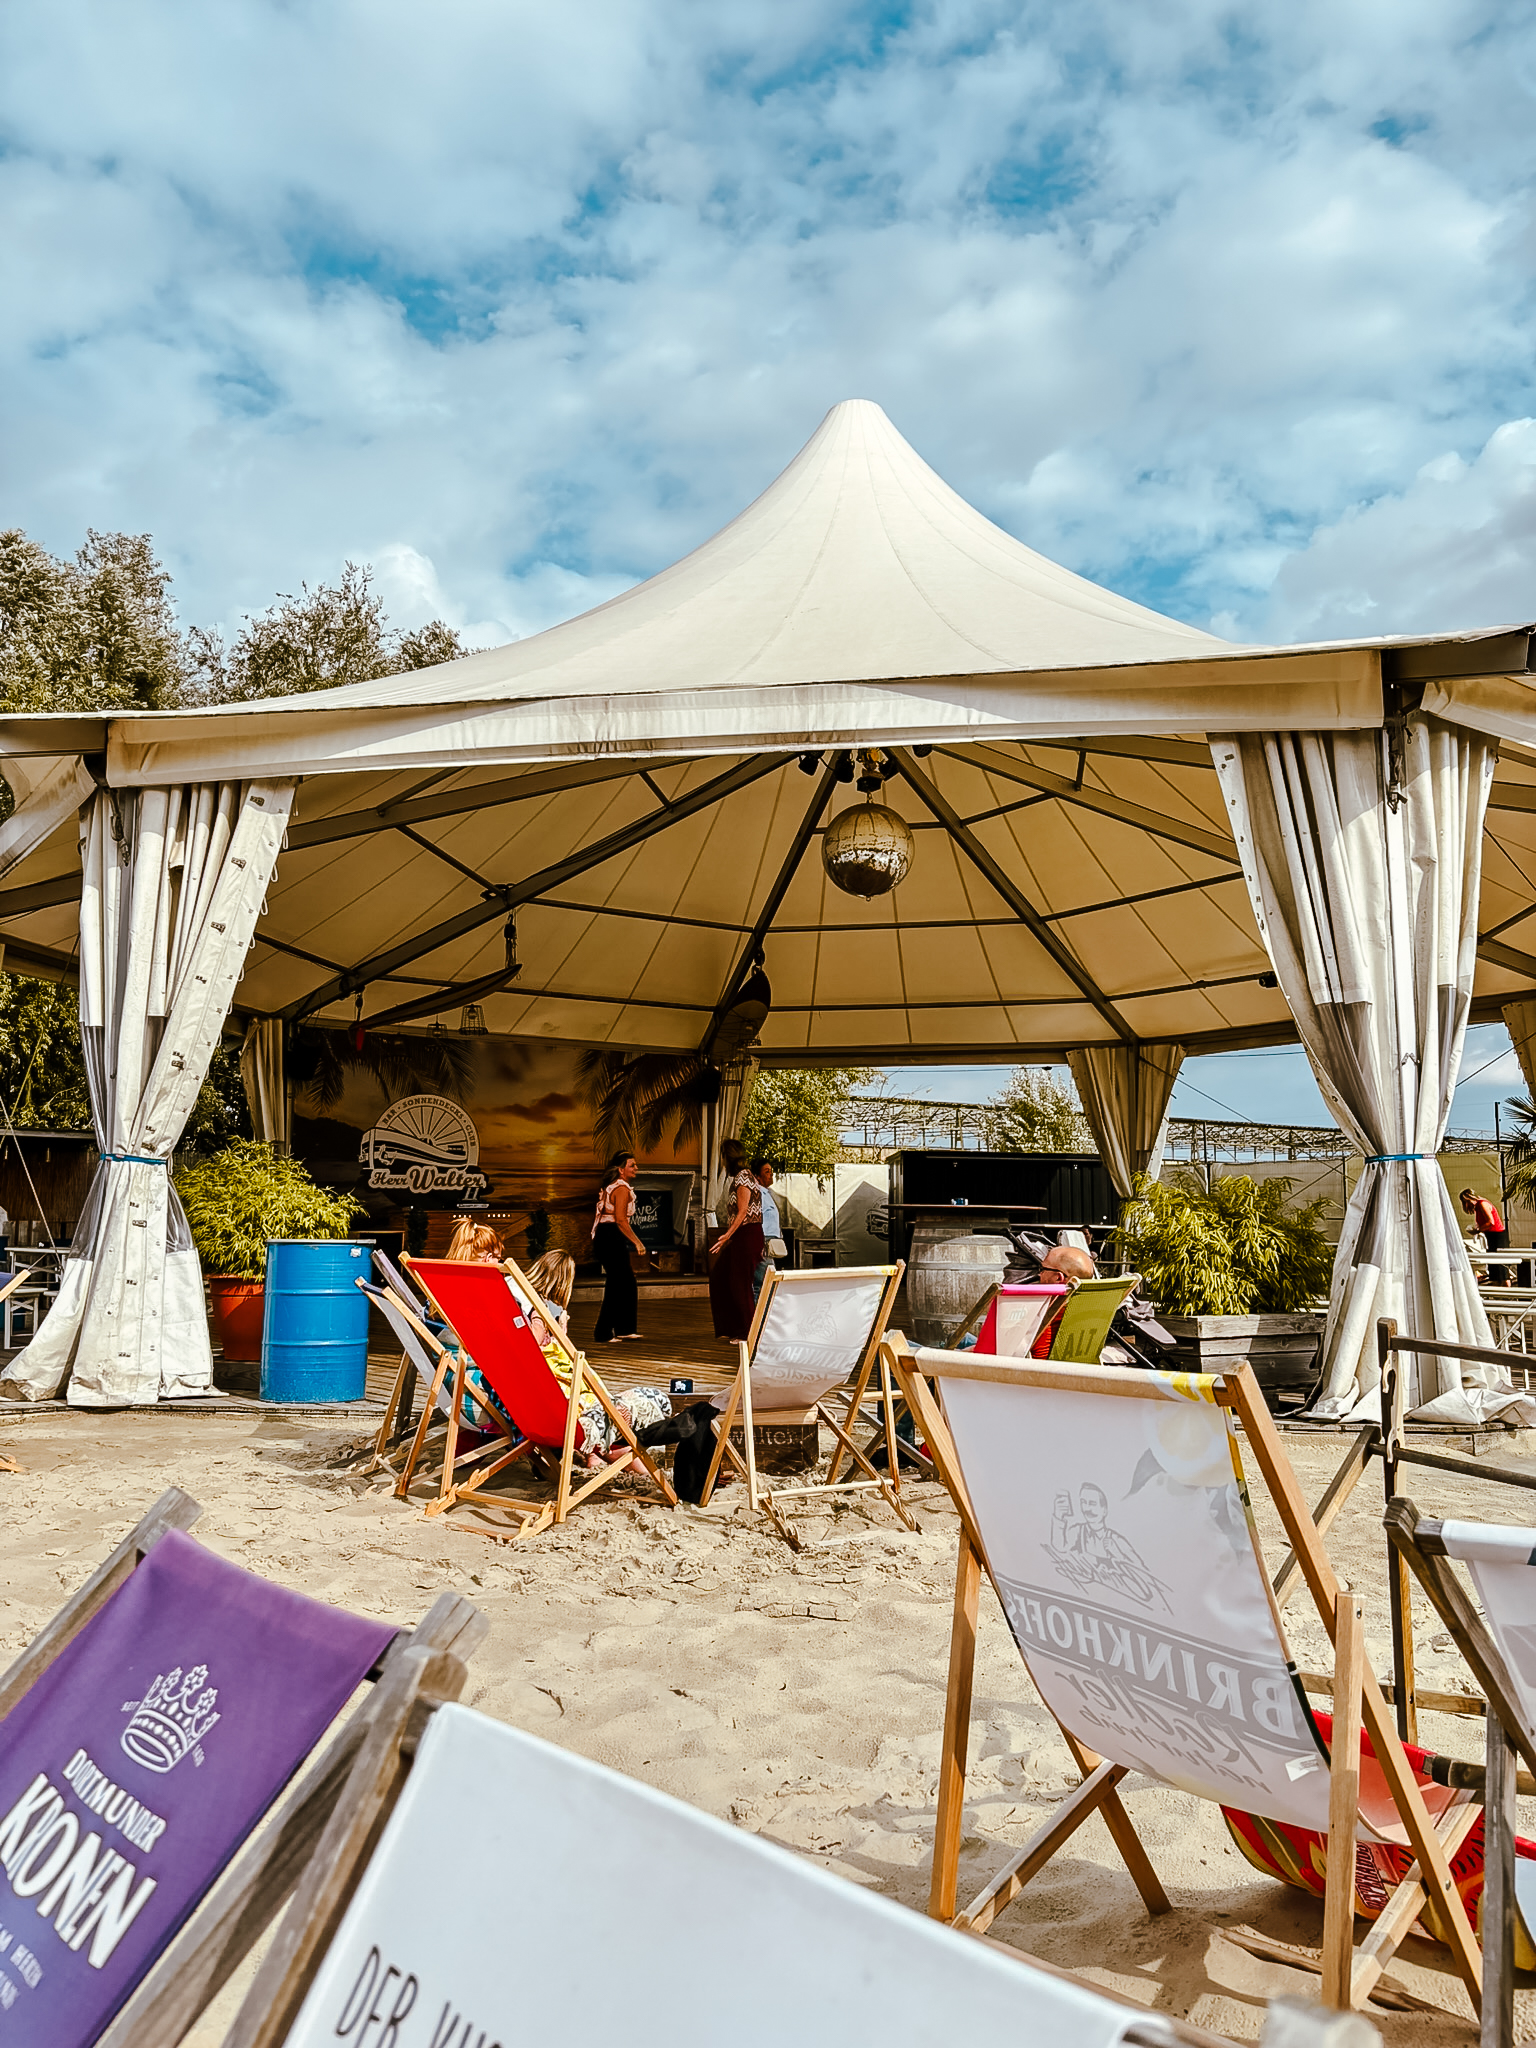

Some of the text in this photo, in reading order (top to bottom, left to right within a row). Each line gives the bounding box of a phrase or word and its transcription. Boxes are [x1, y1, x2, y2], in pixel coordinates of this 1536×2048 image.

[382, 1109, 398, 1125] BAR
[465, 1124, 477, 1147] CLUB
[370, 1167, 484, 1192] Herr Walter
[728, 1425, 798, 1446] wlter
[62, 1748, 168, 1854] DORTMUNDER
[0, 1772, 158, 1969] KRONEN
